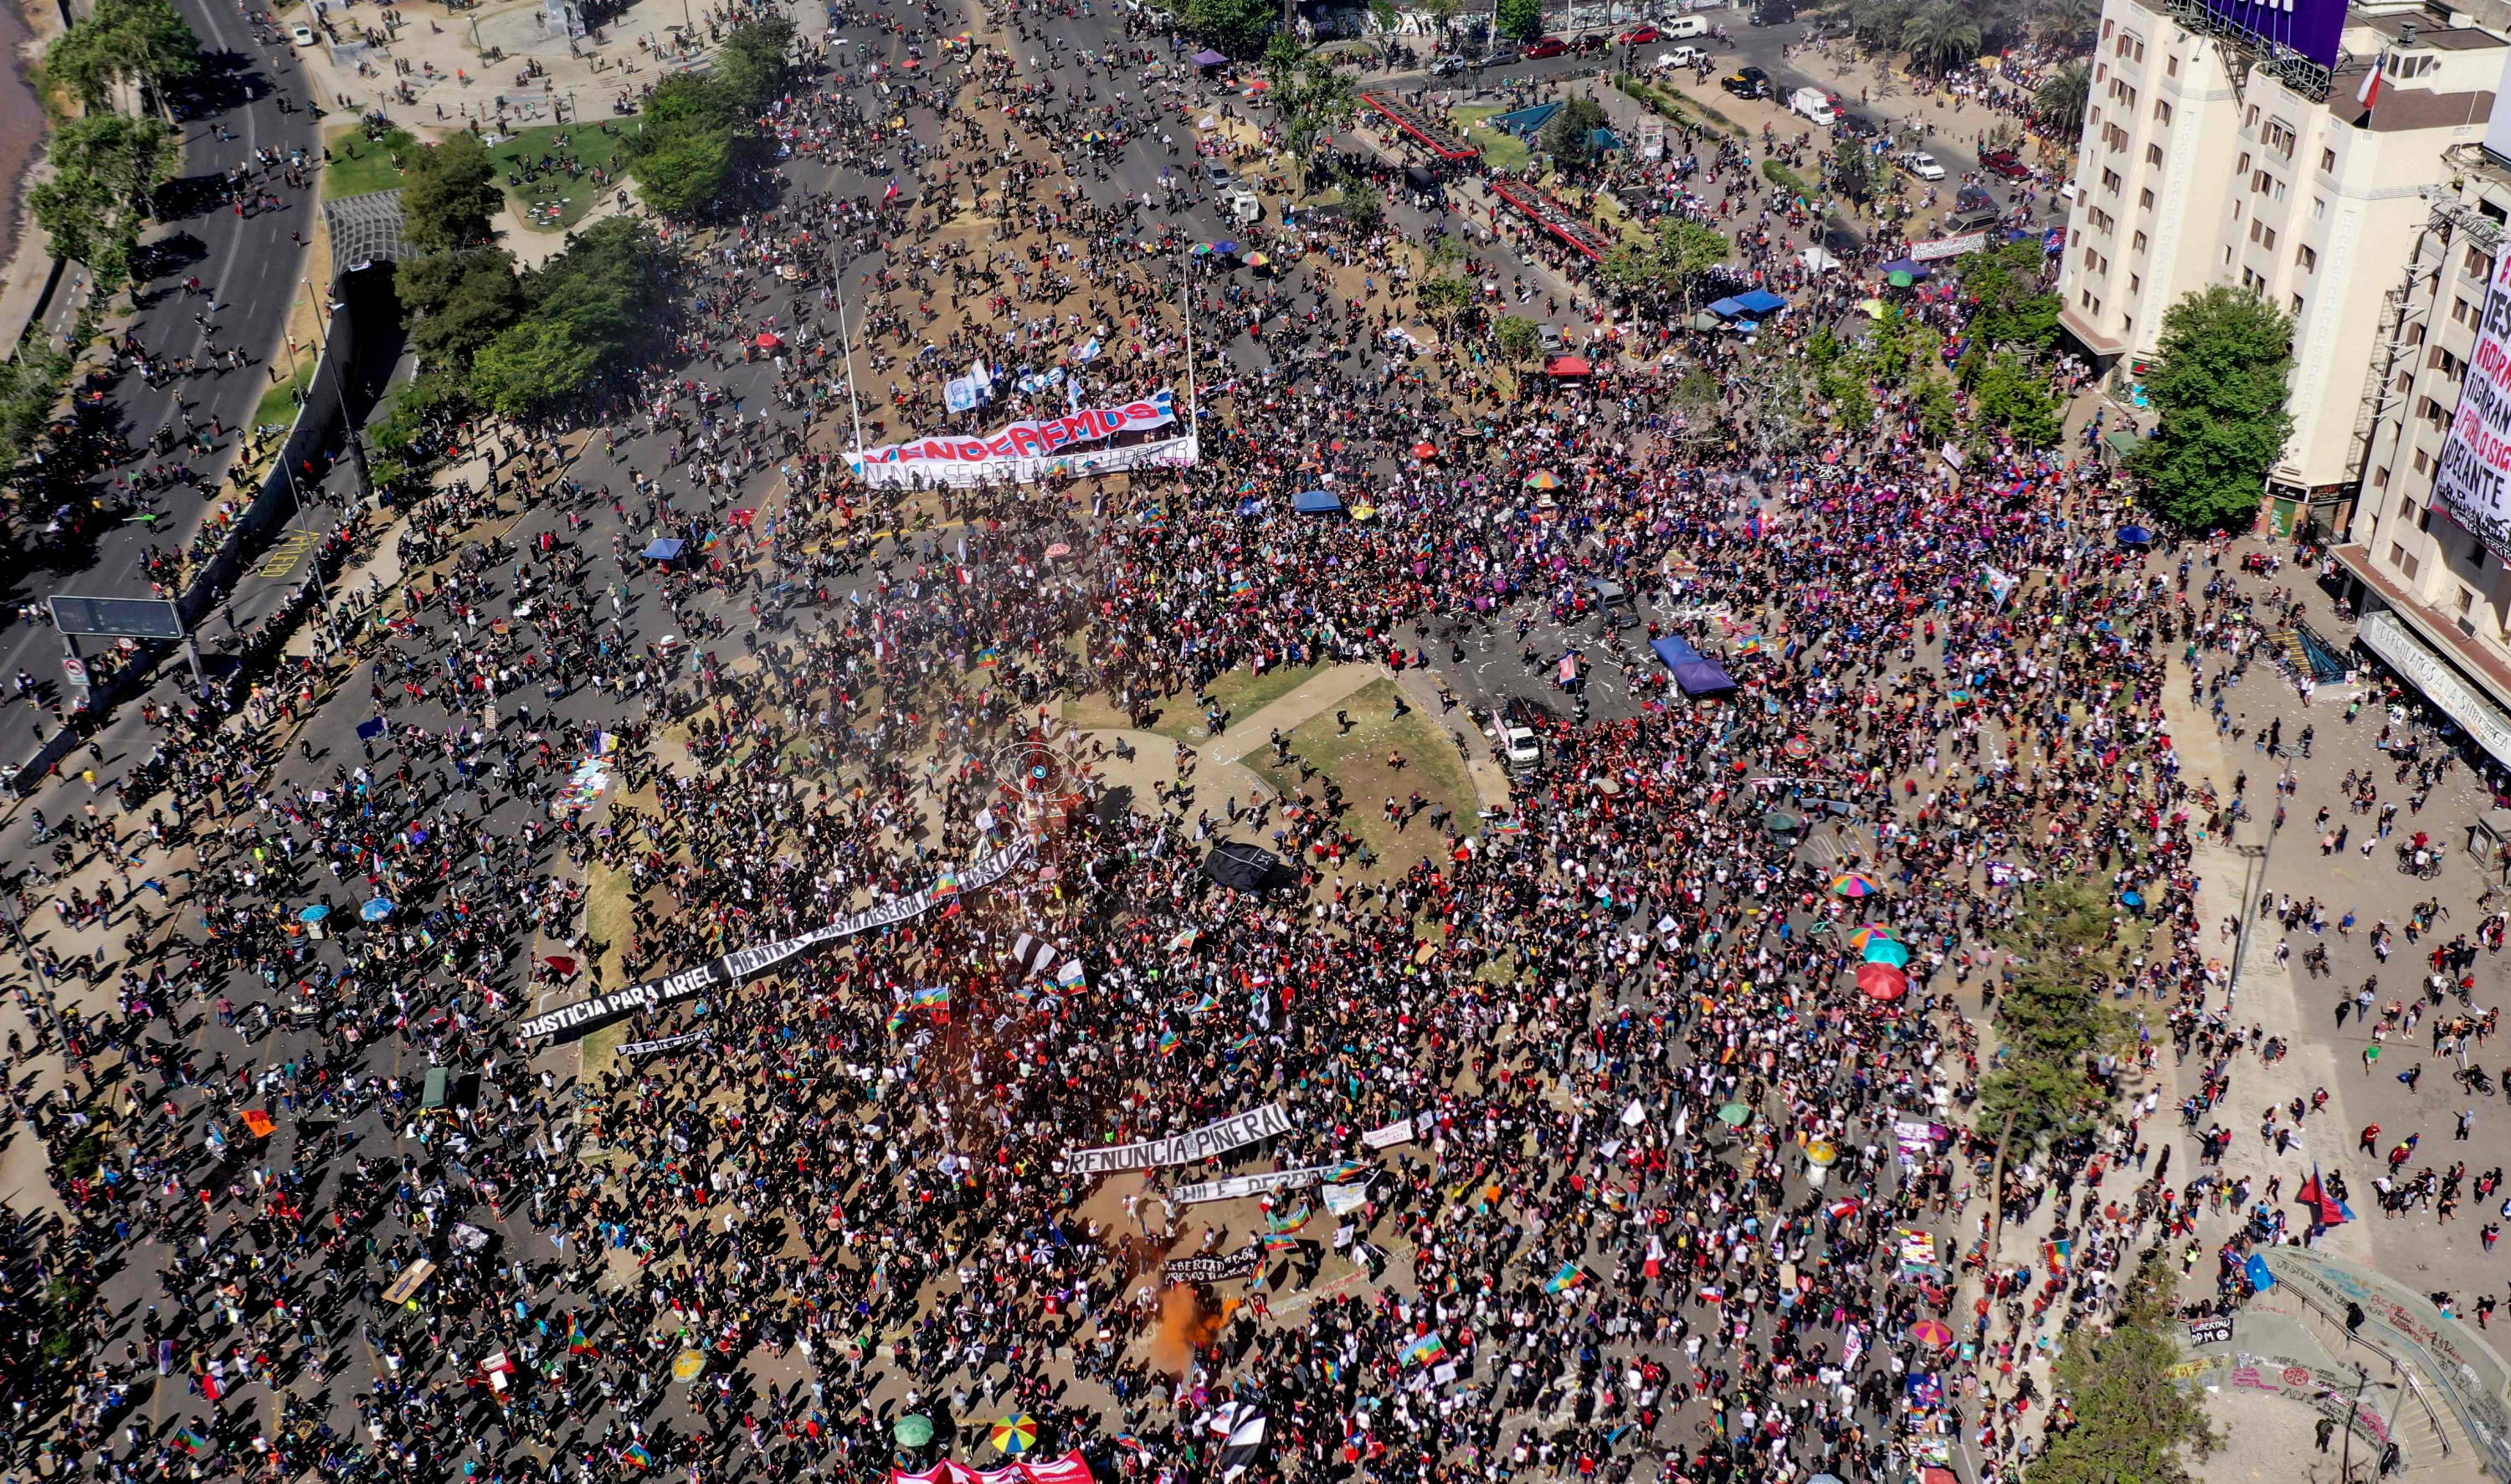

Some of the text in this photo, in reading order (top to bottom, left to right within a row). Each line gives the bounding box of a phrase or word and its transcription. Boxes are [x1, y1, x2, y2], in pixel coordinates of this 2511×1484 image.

[866, 463, 935, 489] NUNCA
[2442, 437, 2505, 510] ADELANTE
[608, 987, 659, 1013] PARA
[1069, 1106, 1286, 1172] RENUNCIA PIÑERA!
